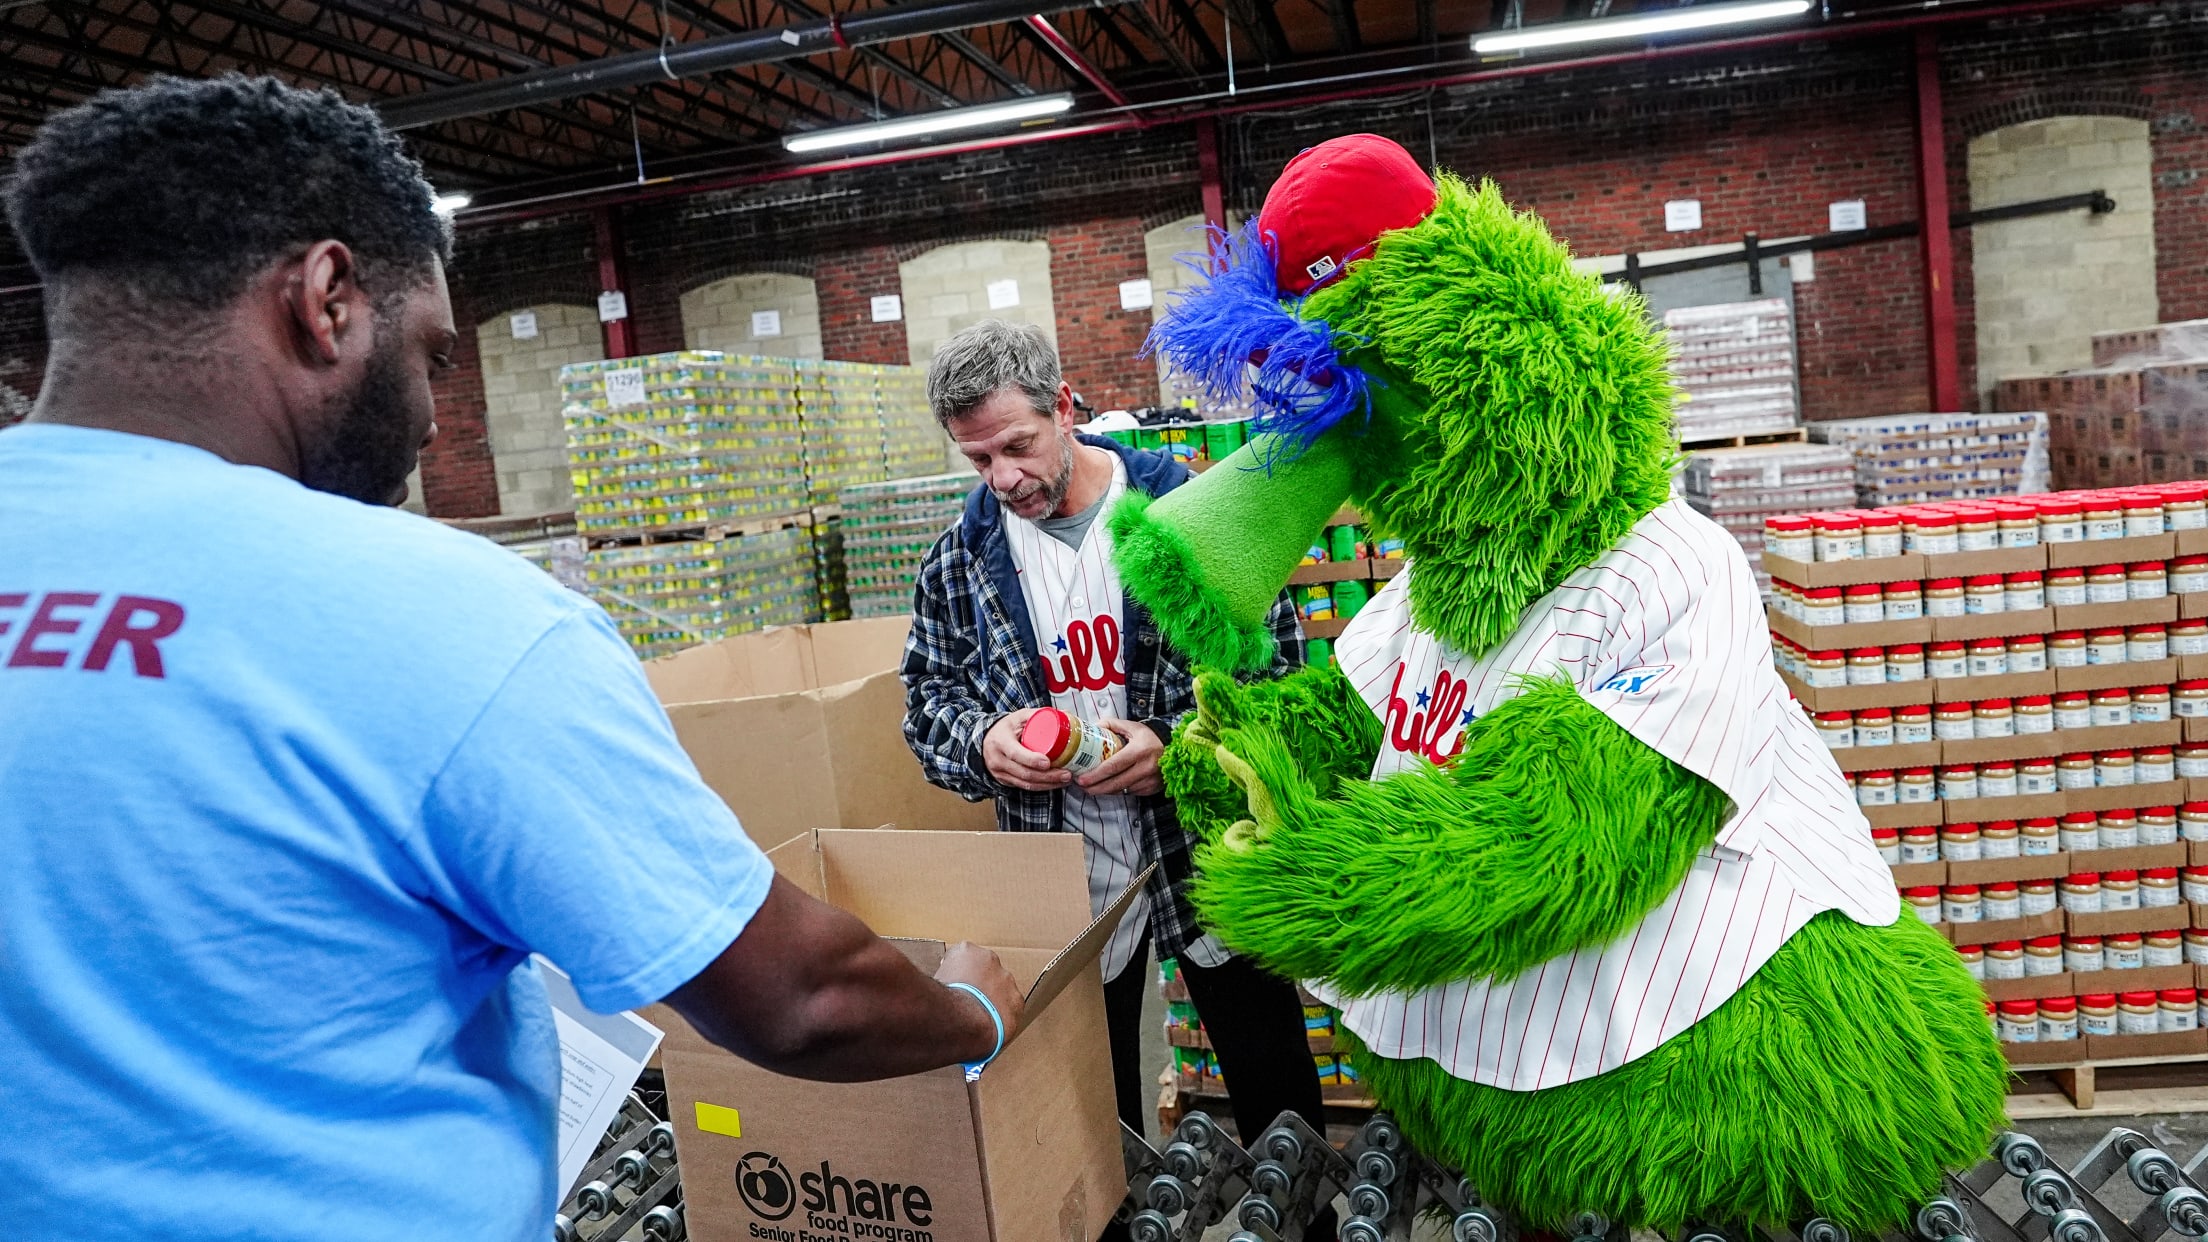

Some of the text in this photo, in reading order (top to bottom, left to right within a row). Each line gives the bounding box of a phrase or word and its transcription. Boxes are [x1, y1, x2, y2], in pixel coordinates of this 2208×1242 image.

[799, 1159, 933, 1227] share
[749, 1222, 795, 1242] Senior
[807, 1210, 933, 1242] food program
